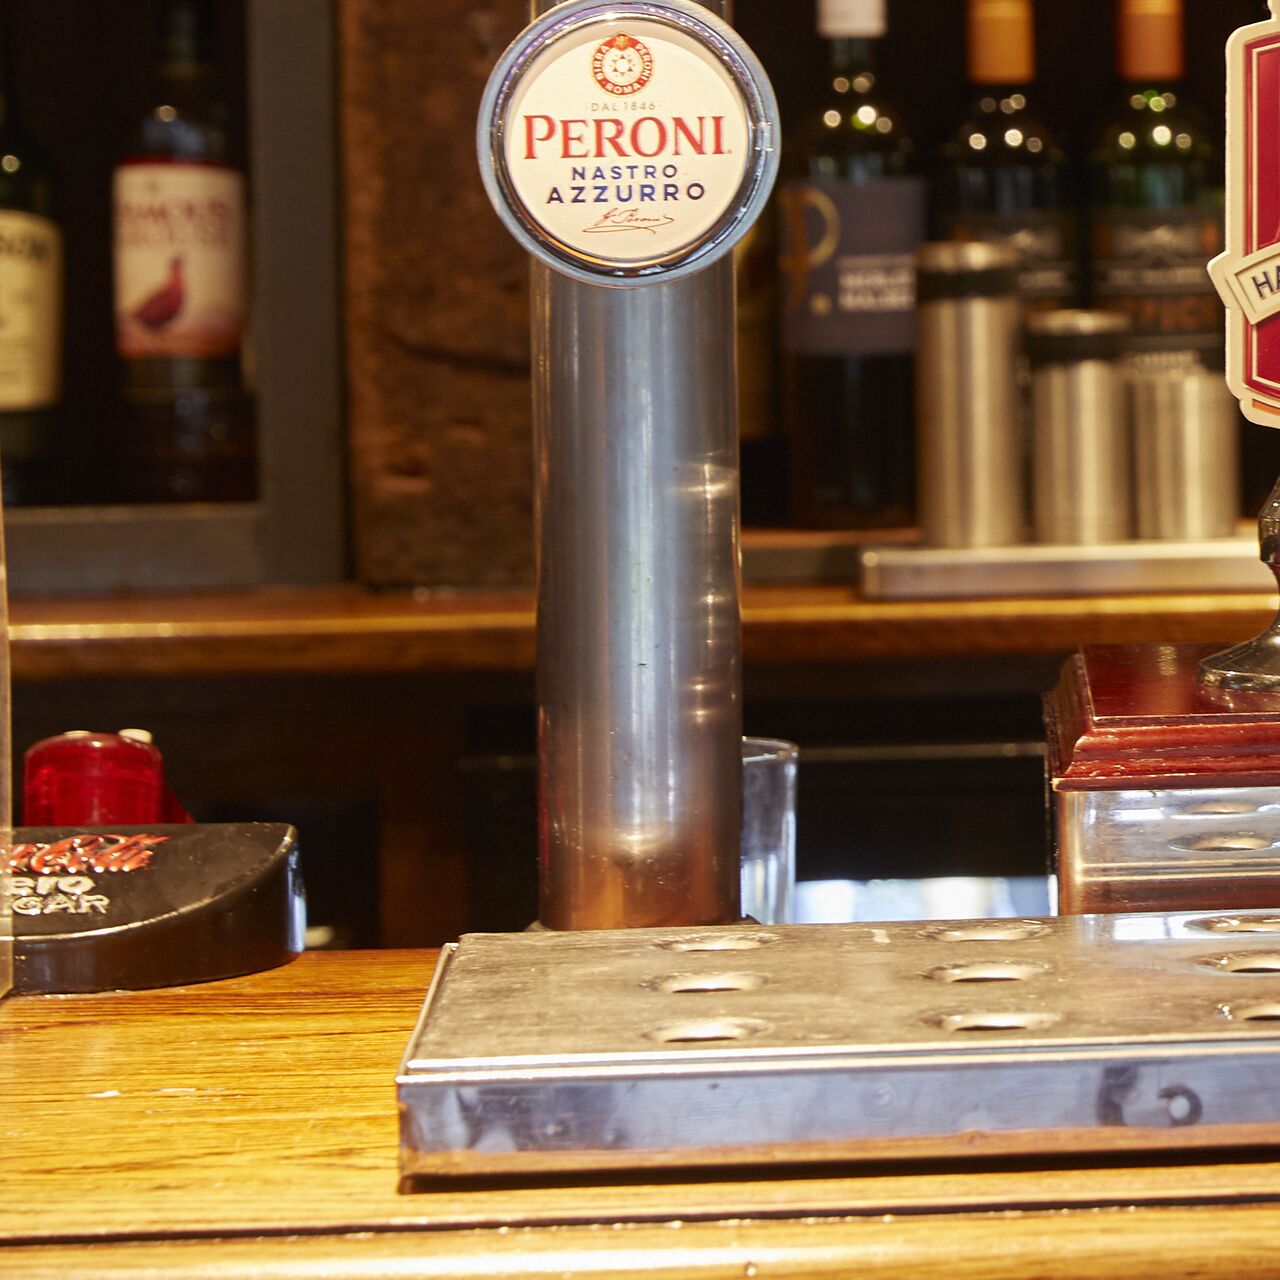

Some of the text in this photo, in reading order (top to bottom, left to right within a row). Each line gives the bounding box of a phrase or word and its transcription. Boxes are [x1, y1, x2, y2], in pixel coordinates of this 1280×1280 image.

[604, 82, 642, 95] ROMA
[591, 101, 656, 112] DAL 1846
[523, 115, 727, 160] PERONI
[572, 164, 678, 181] NASTRO
[547, 183, 705, 204] AZZURRO
